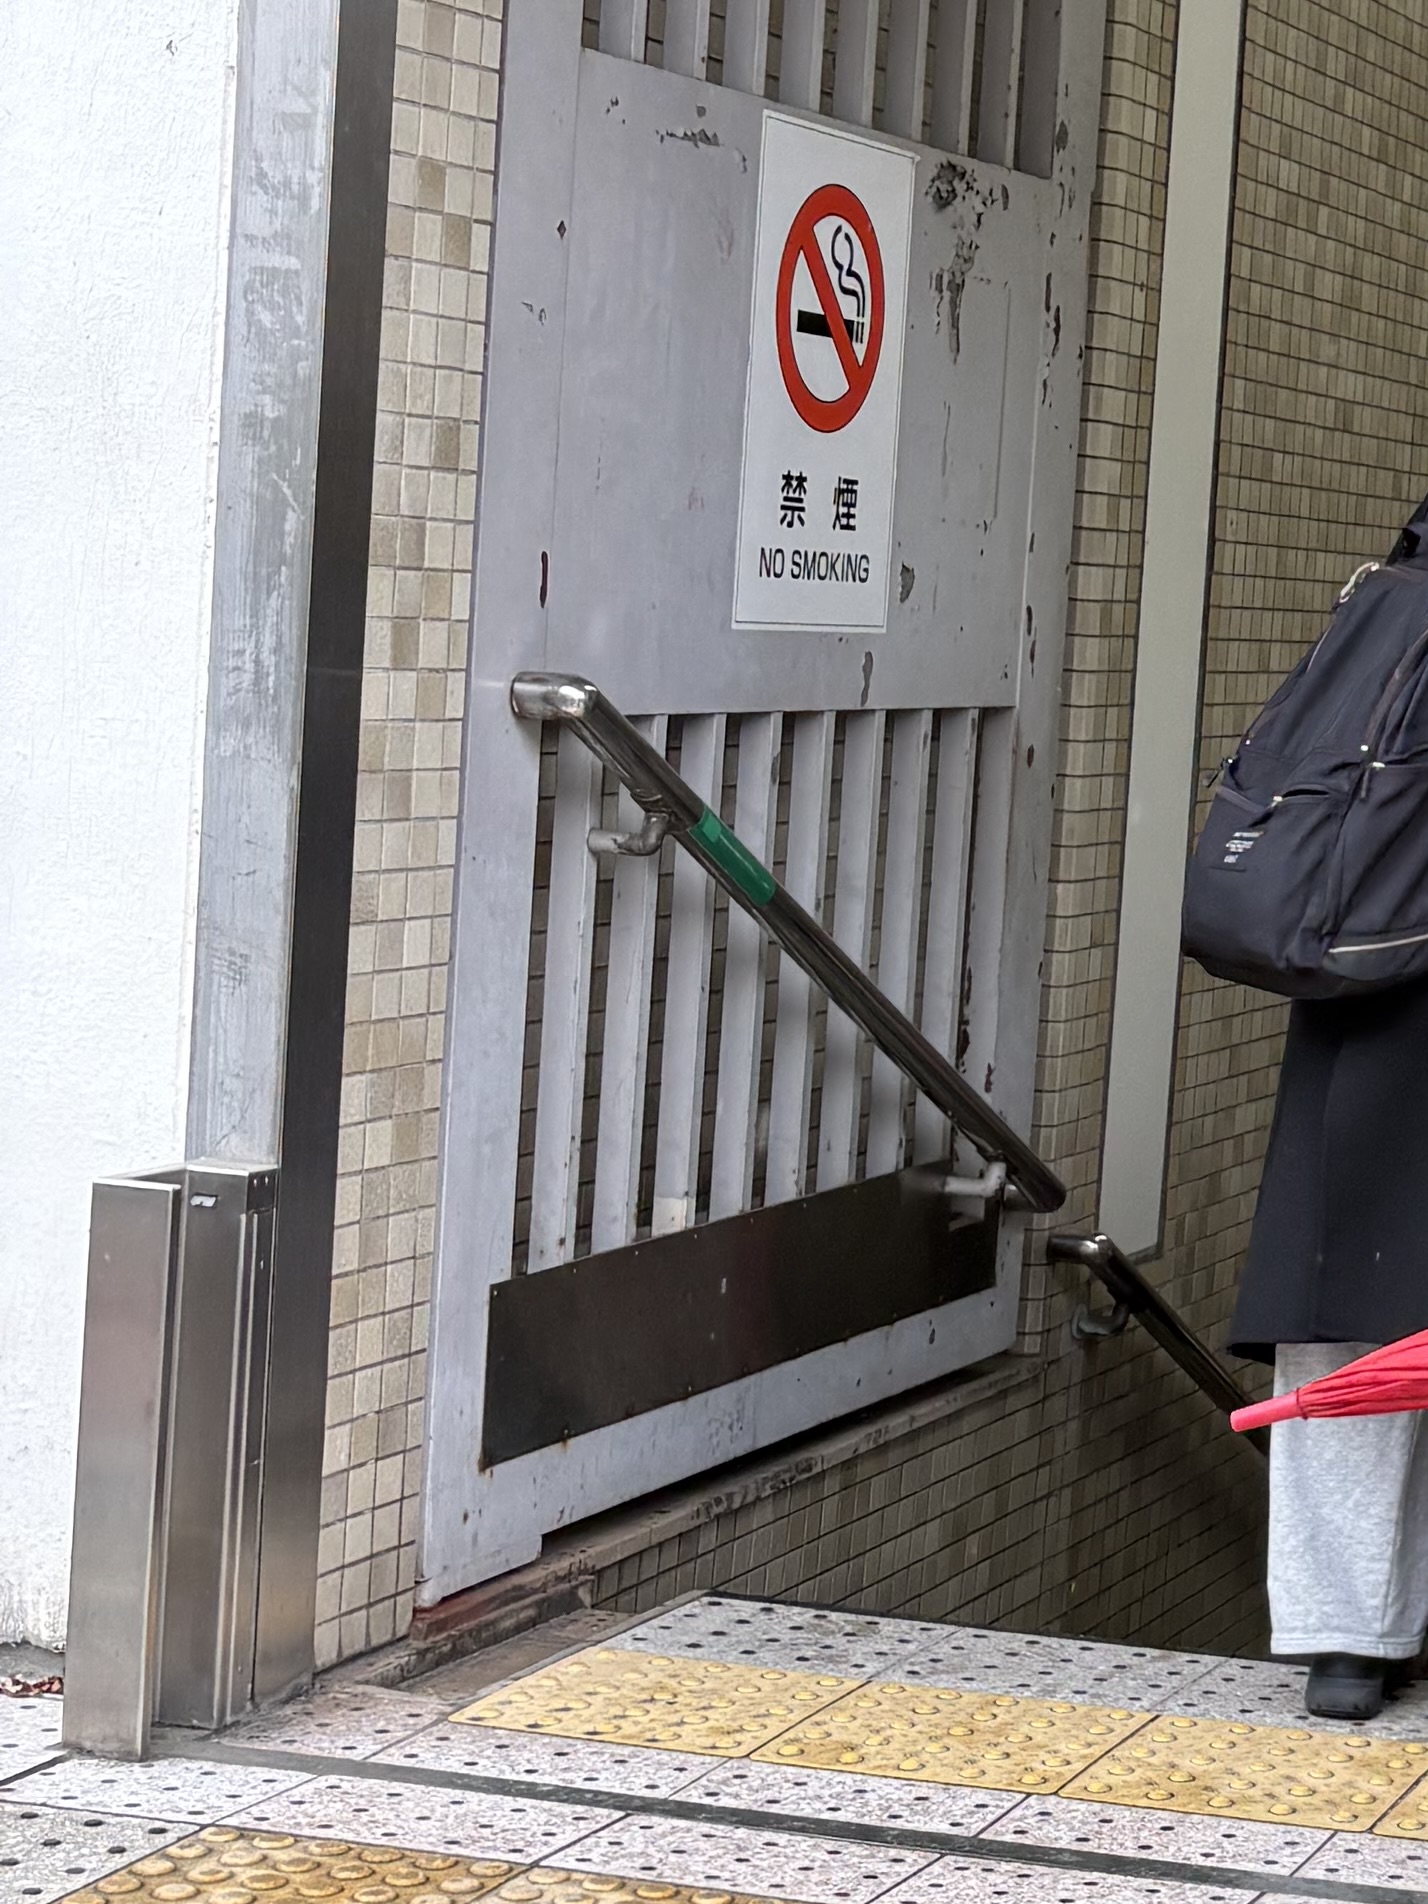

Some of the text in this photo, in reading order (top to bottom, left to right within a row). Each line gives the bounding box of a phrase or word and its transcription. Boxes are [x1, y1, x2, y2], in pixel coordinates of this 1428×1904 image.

[779, 469, 859, 532] 禁煙
[759, 546, 870, 584] NO SMOKING
